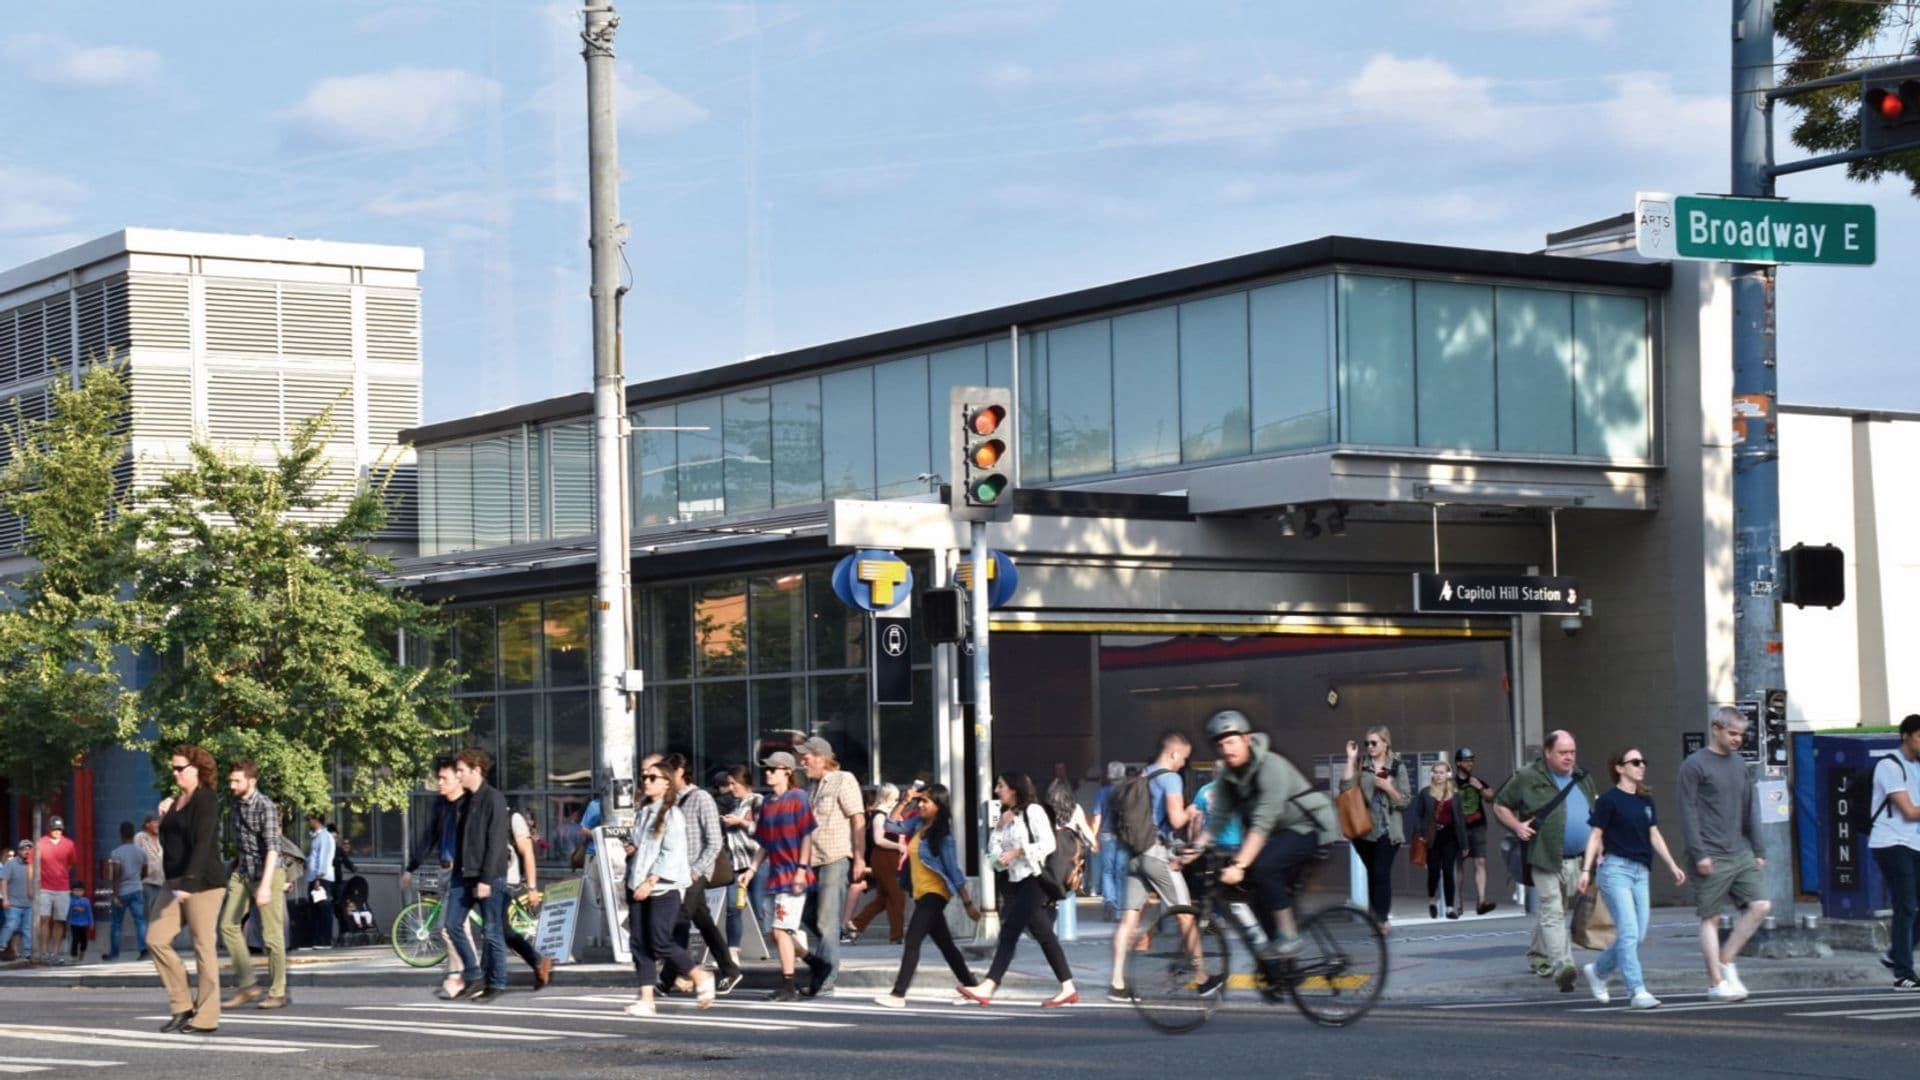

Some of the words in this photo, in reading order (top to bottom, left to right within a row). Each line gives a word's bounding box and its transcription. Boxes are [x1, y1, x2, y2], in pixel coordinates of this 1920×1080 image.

[1640, 214, 1670, 228] ARTS
[1689, 210, 1826, 257] Broadway
[1844, 223, 1859, 250] E
[1456, 585, 1496, 603] Capitol
[1499, 586, 1519, 600] Hill
[1522, 586, 1561, 601] Station
[1838, 776, 1849, 862] JOHN
